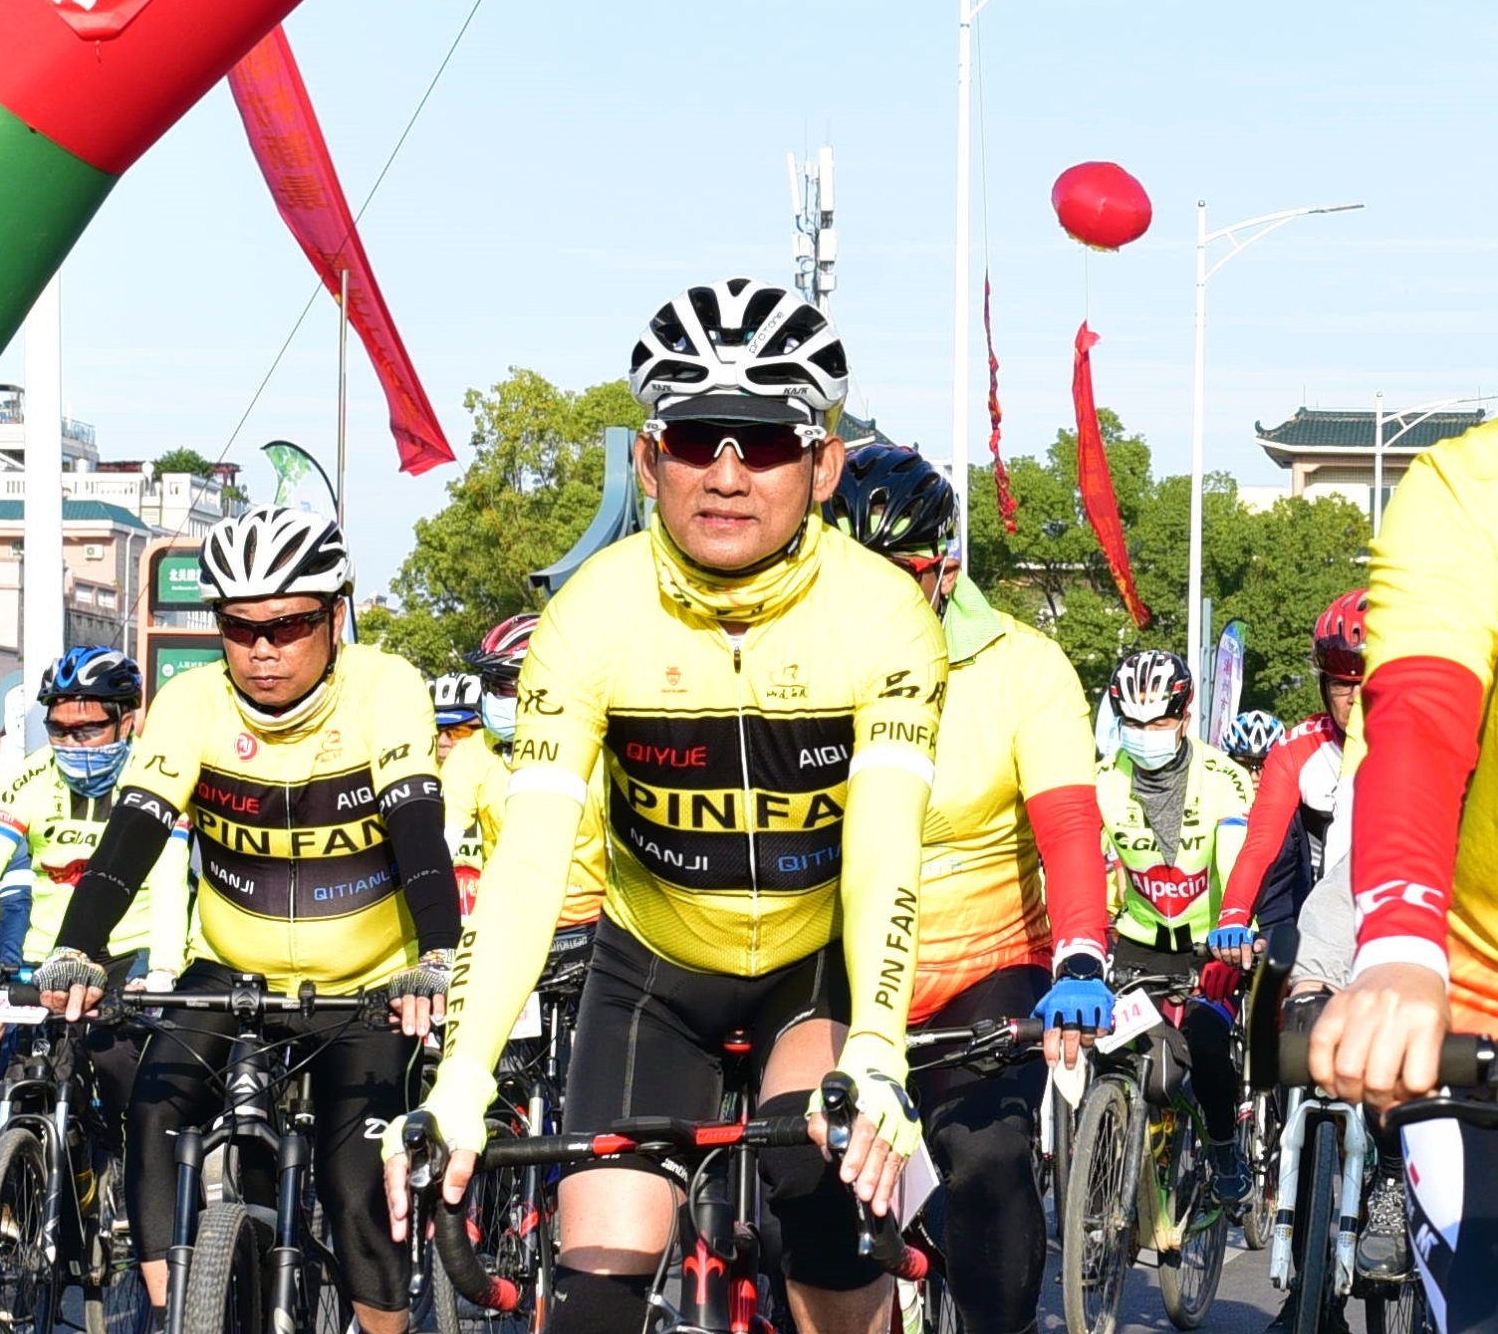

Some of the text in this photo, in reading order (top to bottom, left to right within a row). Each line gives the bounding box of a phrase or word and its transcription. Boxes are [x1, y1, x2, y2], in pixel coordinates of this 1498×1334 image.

[625, 742, 849, 769] QIYUE AIQI
[197, 780, 261, 815] QIYUE
[628, 779, 738, 830] PIN
[197, 814, 271, 856] PIN
[629, 827, 709, 872] NANJI
[209, 860, 255, 896] NANJI
[1131, 874, 1206, 899] Alpecin
[874, 886, 918, 1011] PIN FAN
